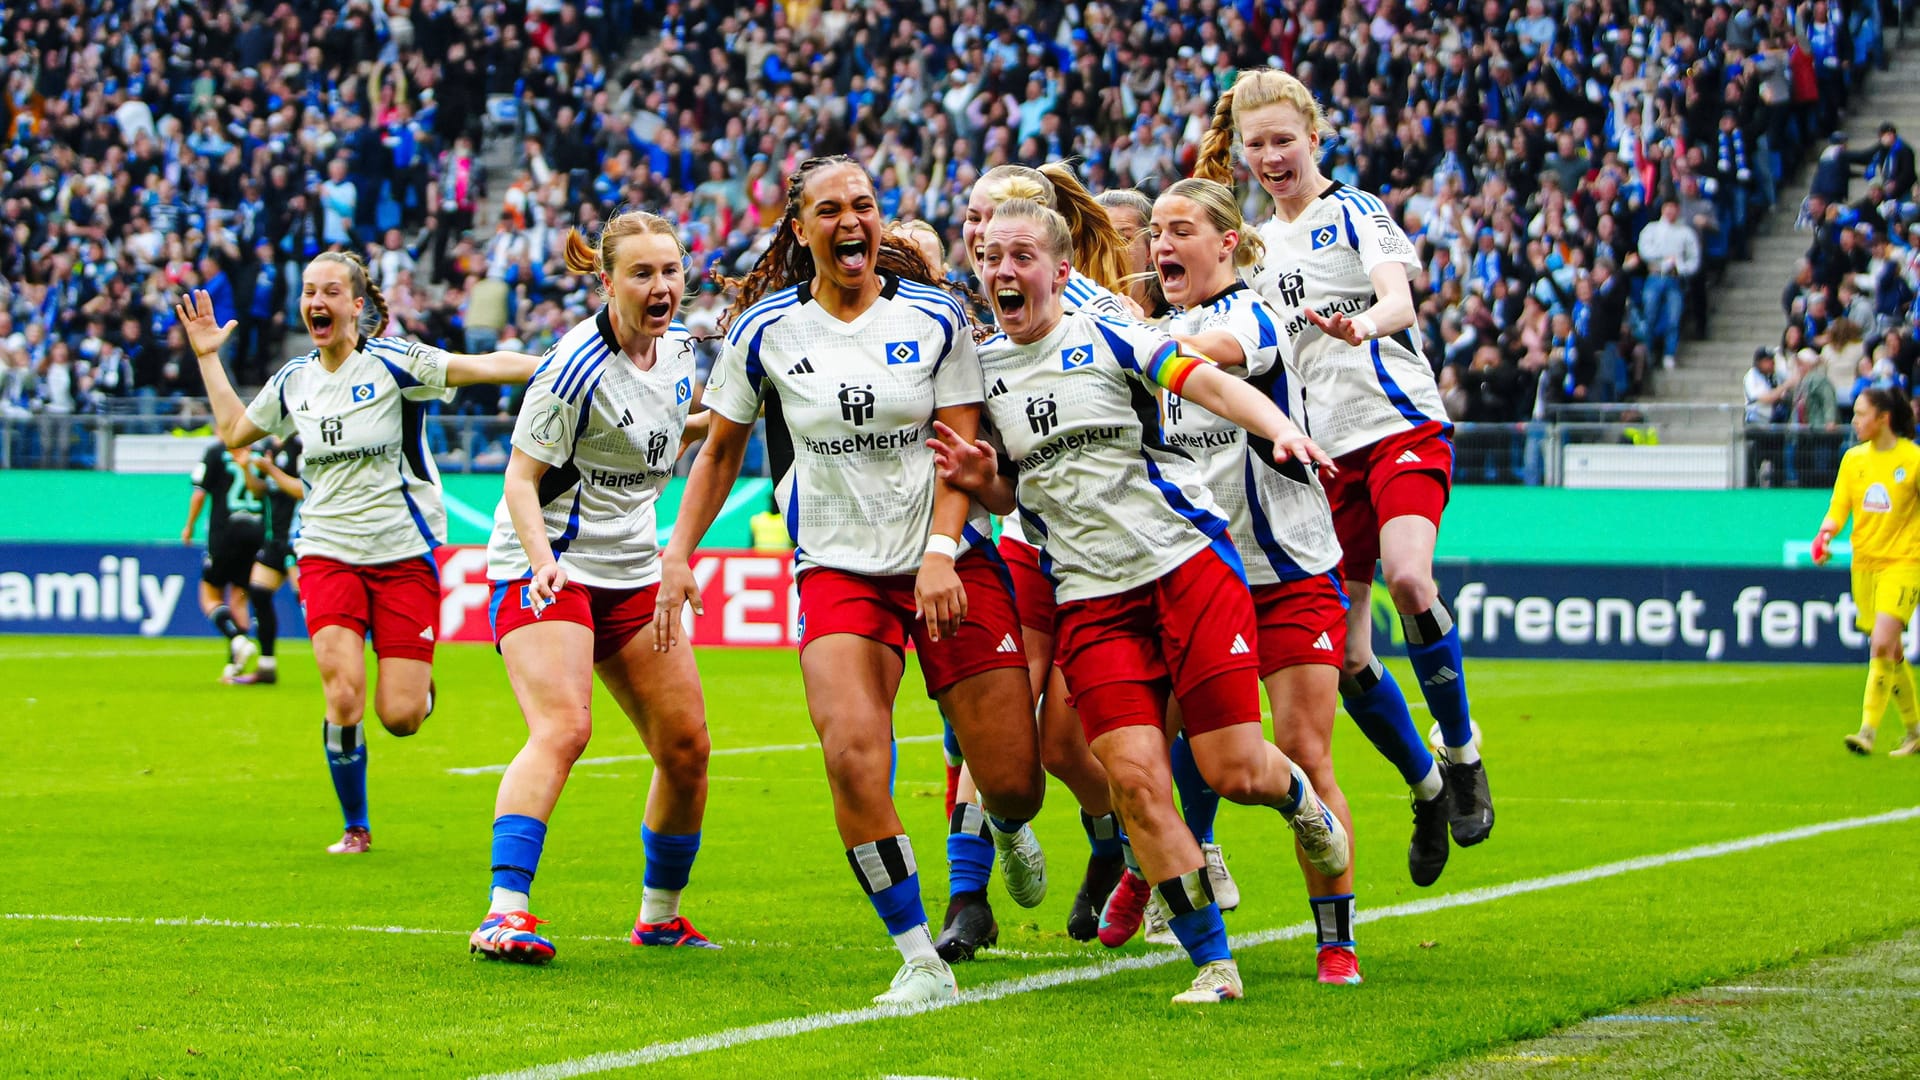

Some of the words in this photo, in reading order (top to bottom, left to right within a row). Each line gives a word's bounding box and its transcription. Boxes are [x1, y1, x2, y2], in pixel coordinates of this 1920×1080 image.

[304, 444, 387, 466] seMerkur
[1019, 426, 1124, 473] anseMerkur
[1453, 583, 1725, 660] freenet,
